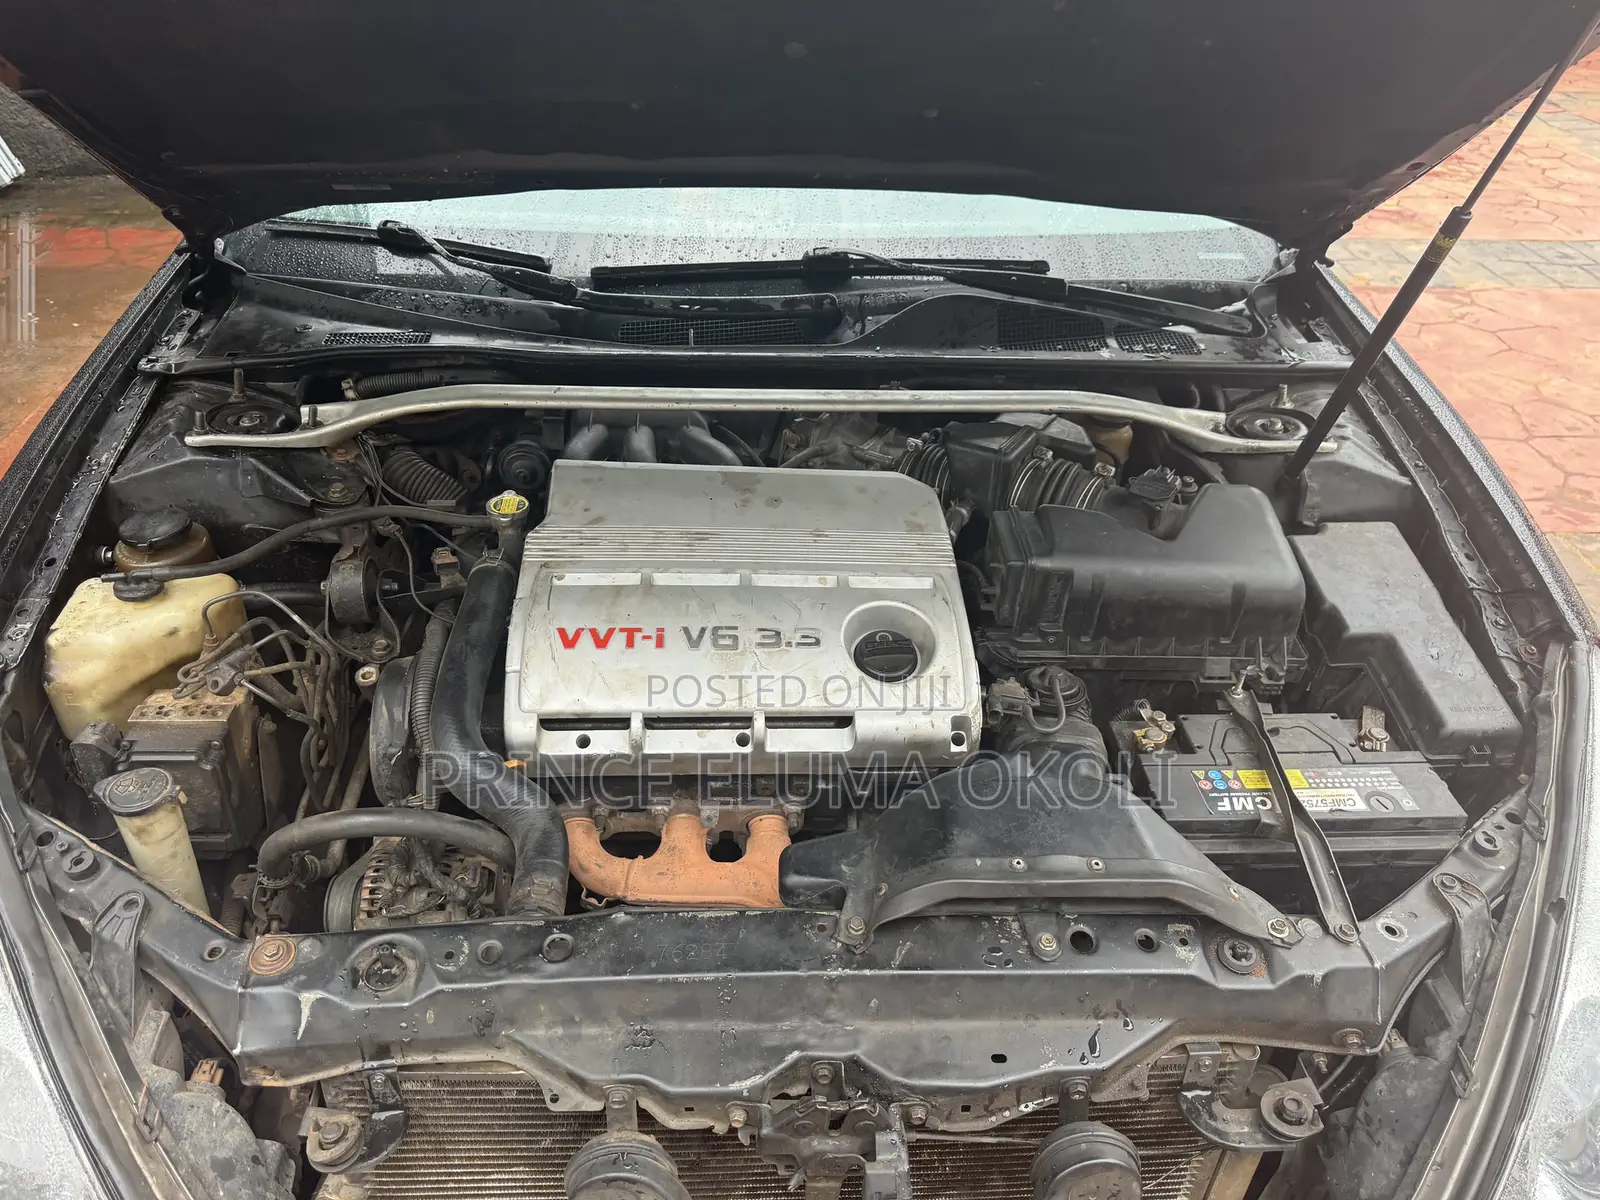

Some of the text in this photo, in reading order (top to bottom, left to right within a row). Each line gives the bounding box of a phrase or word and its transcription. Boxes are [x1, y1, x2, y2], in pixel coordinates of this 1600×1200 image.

[556, 627, 666, 650] VVT-i
[680, 625, 740, 651] V6
[1217, 796, 1273, 811] CMF
